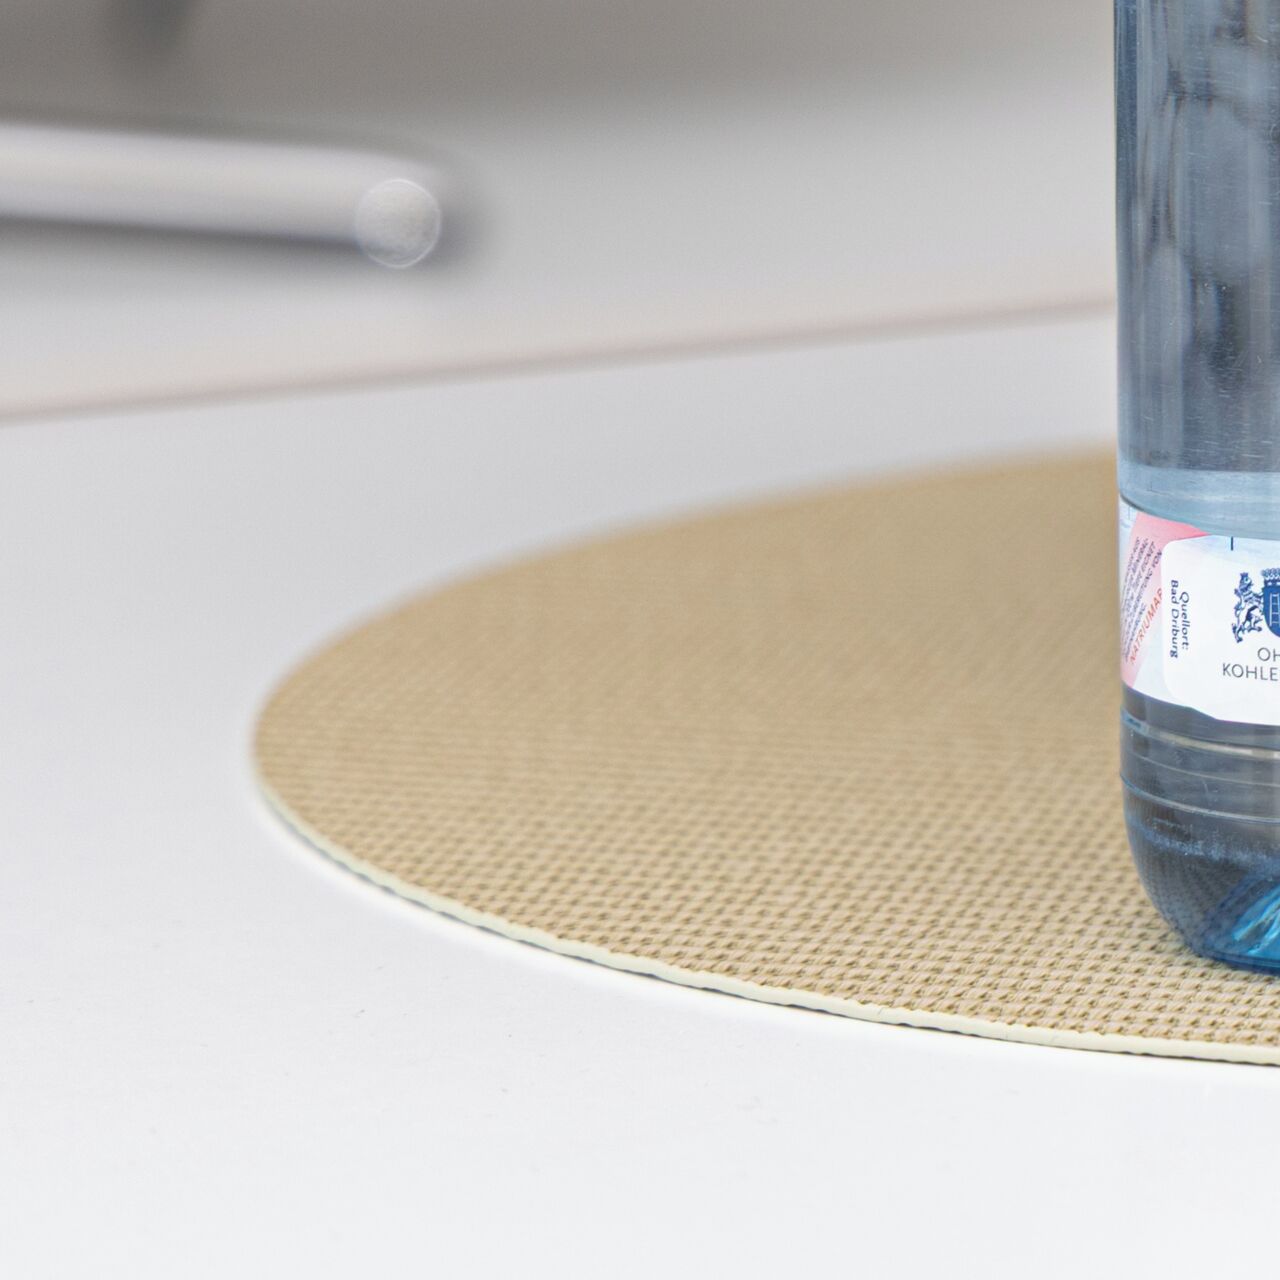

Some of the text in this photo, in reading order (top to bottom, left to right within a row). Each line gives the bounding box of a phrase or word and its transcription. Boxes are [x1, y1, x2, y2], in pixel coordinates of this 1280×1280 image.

[1170, 579, 1180, 659] Bad Driburg
[1179, 592, 1190, 651] Quellort:
